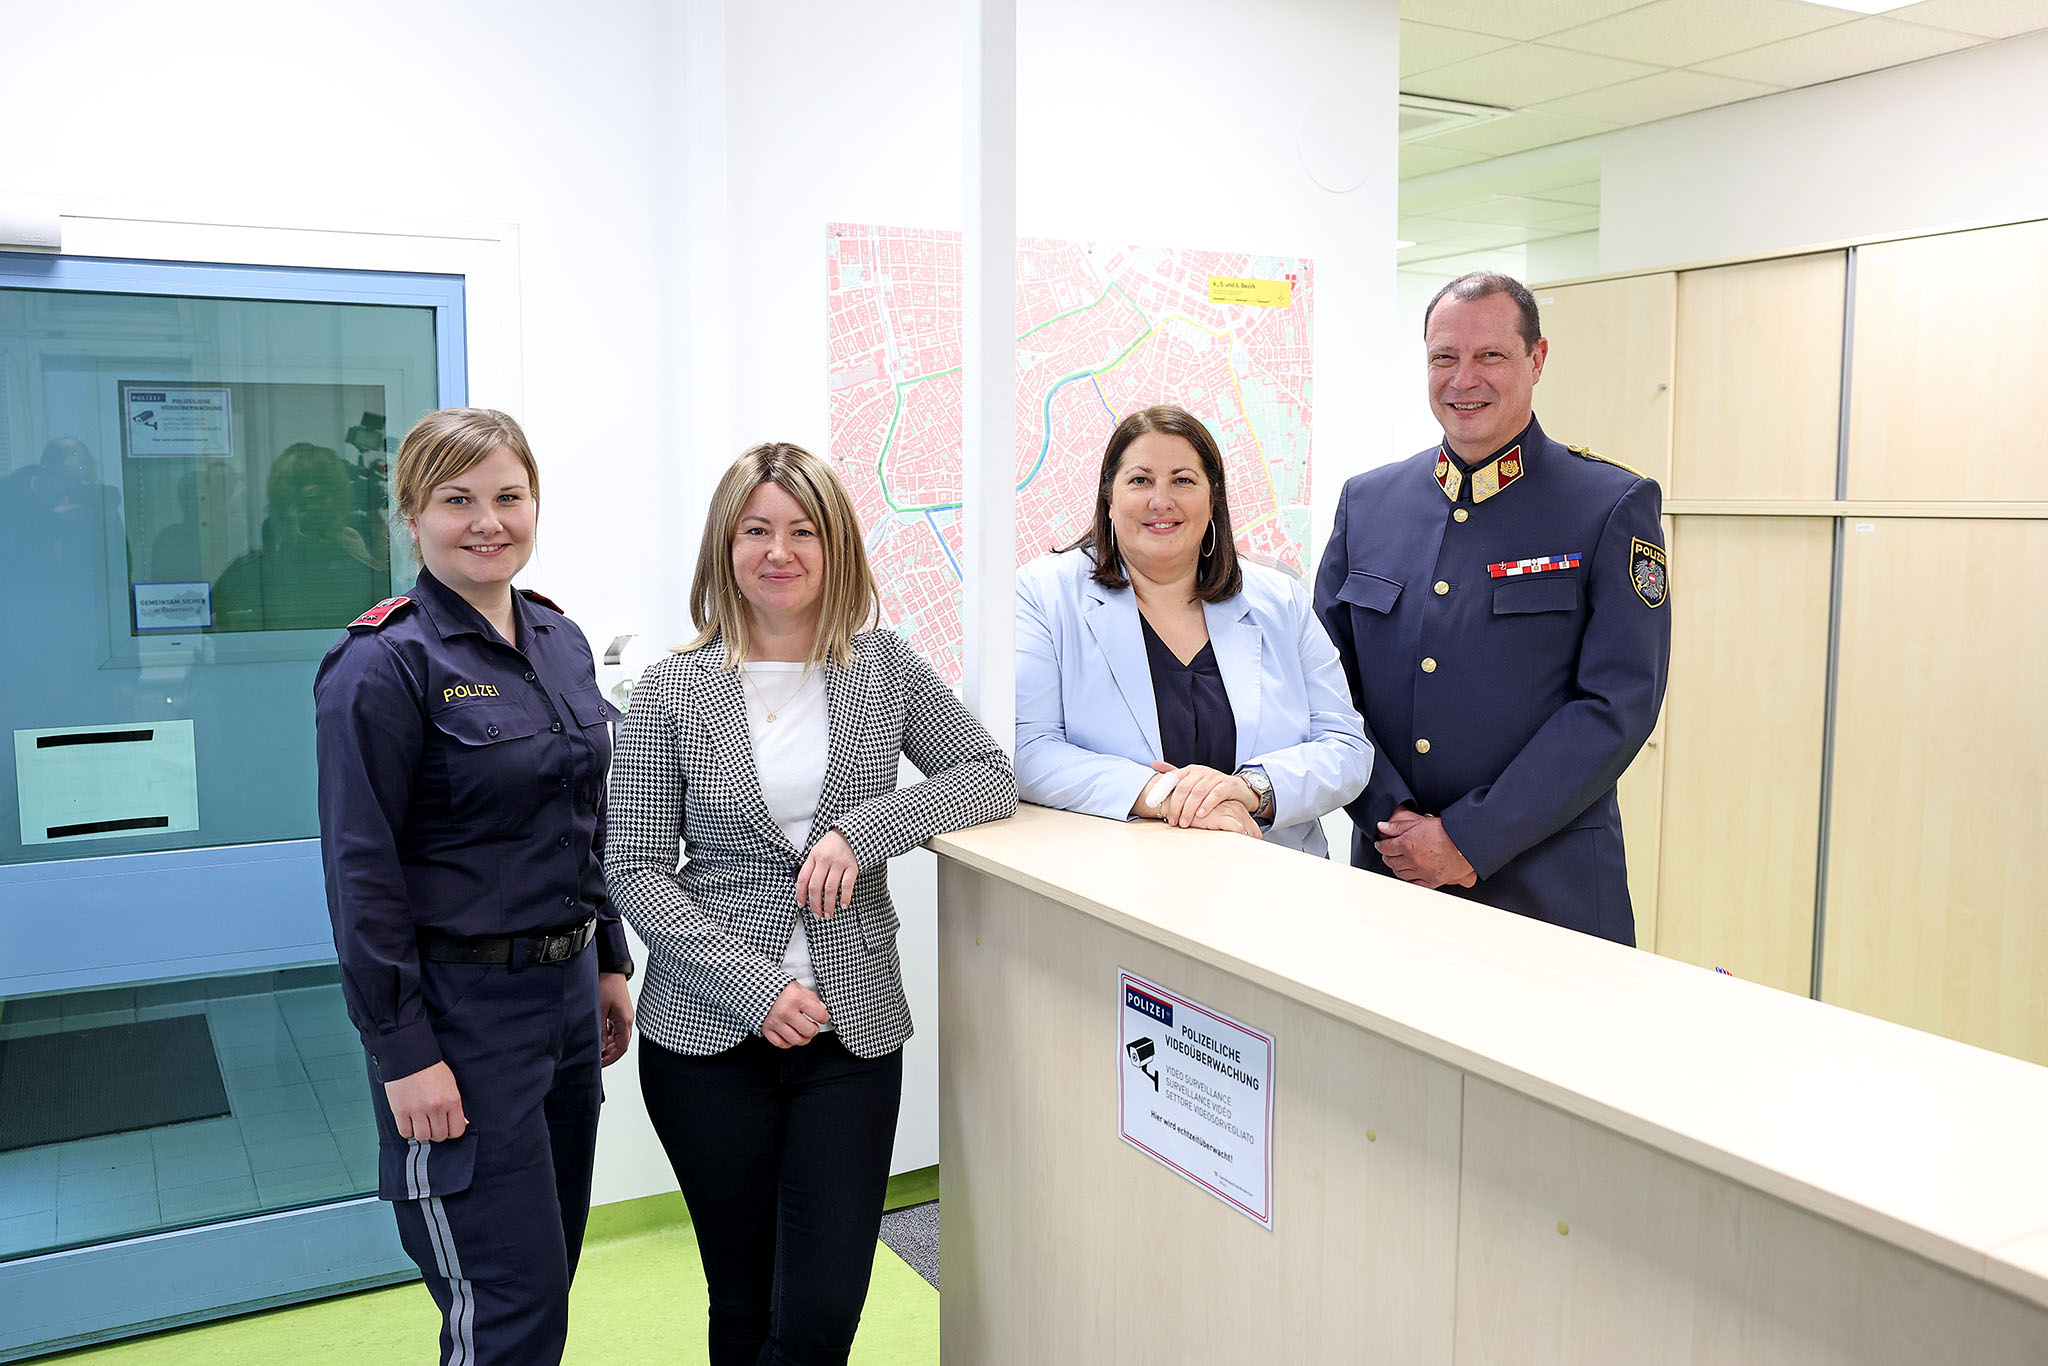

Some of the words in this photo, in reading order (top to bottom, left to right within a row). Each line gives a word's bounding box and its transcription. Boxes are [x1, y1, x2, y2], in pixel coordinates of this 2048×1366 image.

[1635, 543, 1665, 565] POLIZE
[443, 684, 500, 702] POLIZEI
[1128, 992, 1165, 1020] POLIZEI
[1165, 1034, 1260, 1091] VIDEOÜBERWACHUNG
[1182, 1025, 1241, 1064] POLIZEILICHE
[1165, 1064, 1184, 1081] VIDEO
[1185, 1074, 1232, 1106] SURVEILLANCE
[1165, 1077, 1211, 1109] SURVEILLANCE
[1150, 1109, 1163, 1121] Hier
[1163, 1118, 1177, 1131] wird
[1177, 1126, 1233, 1163] echtzeitüberwacht!
[1165, 1089, 1193, 1112] SETTORE
[1194, 1105, 1255, 1145] VIDEOSORVEGLIATO
